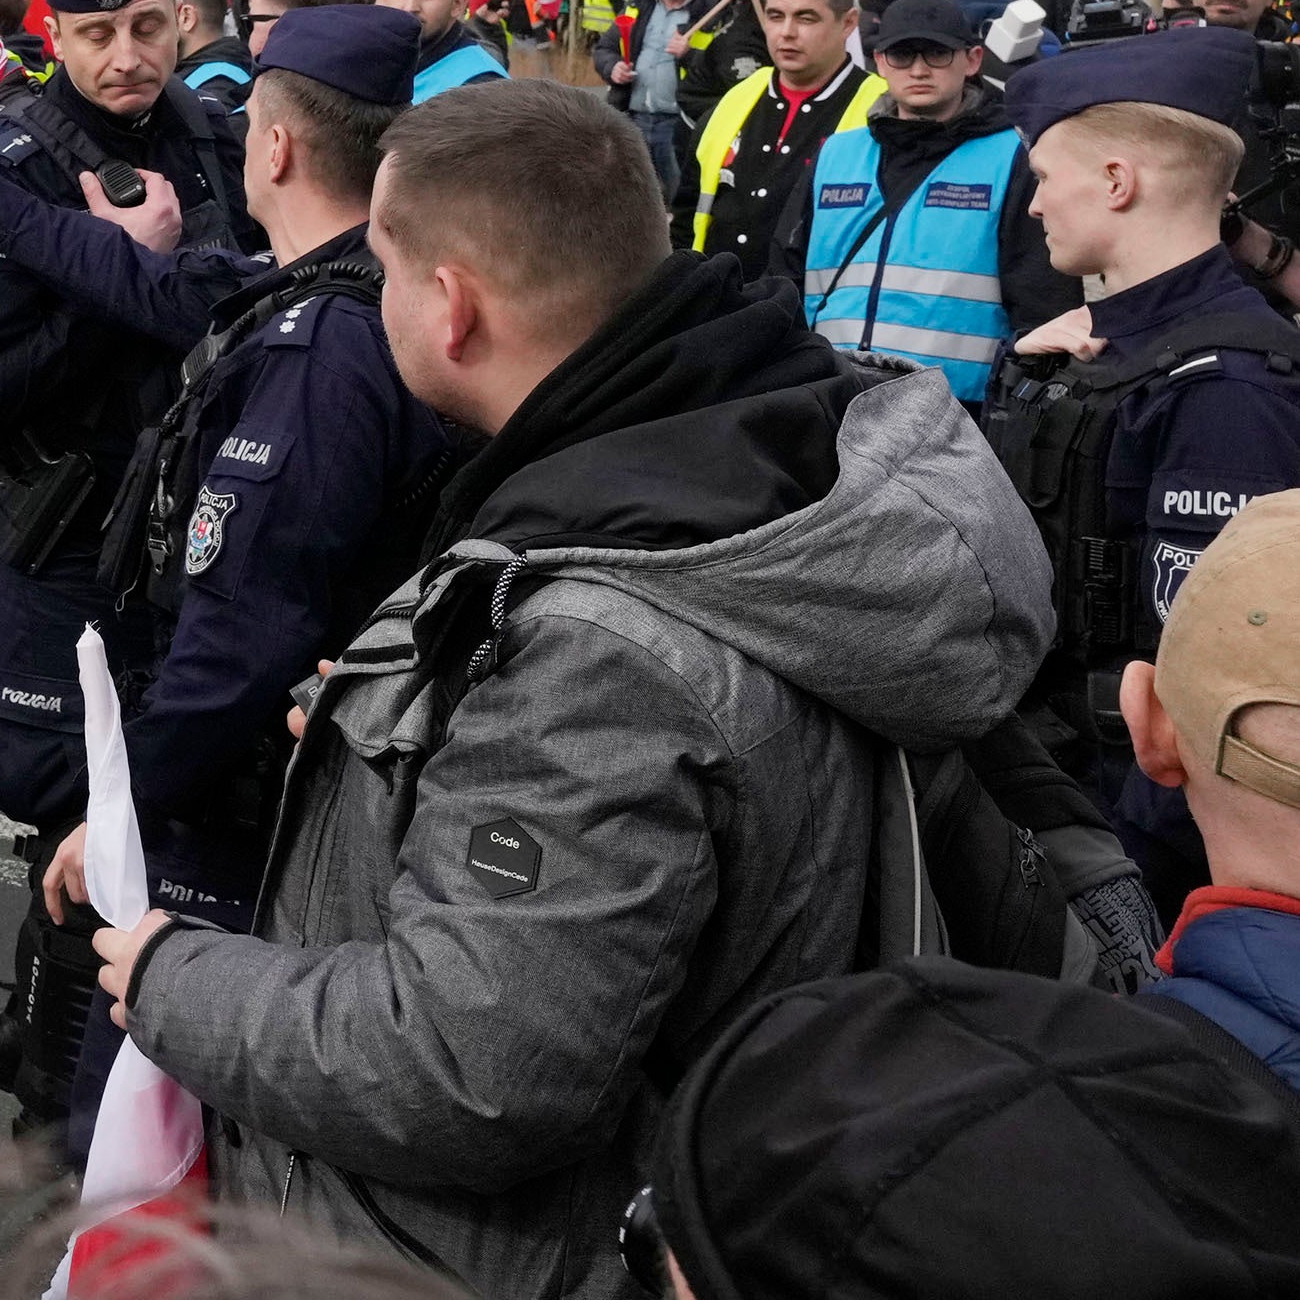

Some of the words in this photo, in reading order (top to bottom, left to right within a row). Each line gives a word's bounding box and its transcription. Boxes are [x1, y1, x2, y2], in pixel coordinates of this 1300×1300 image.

[821, 188, 864, 204] POLICJA
[201, 493, 228, 511] POLICJA
[1163, 490, 1247, 517] POLICJ
[1162, 548, 1199, 567] POL
[2, 687, 62, 713] POLICJA
[490, 831, 520, 849] Code
